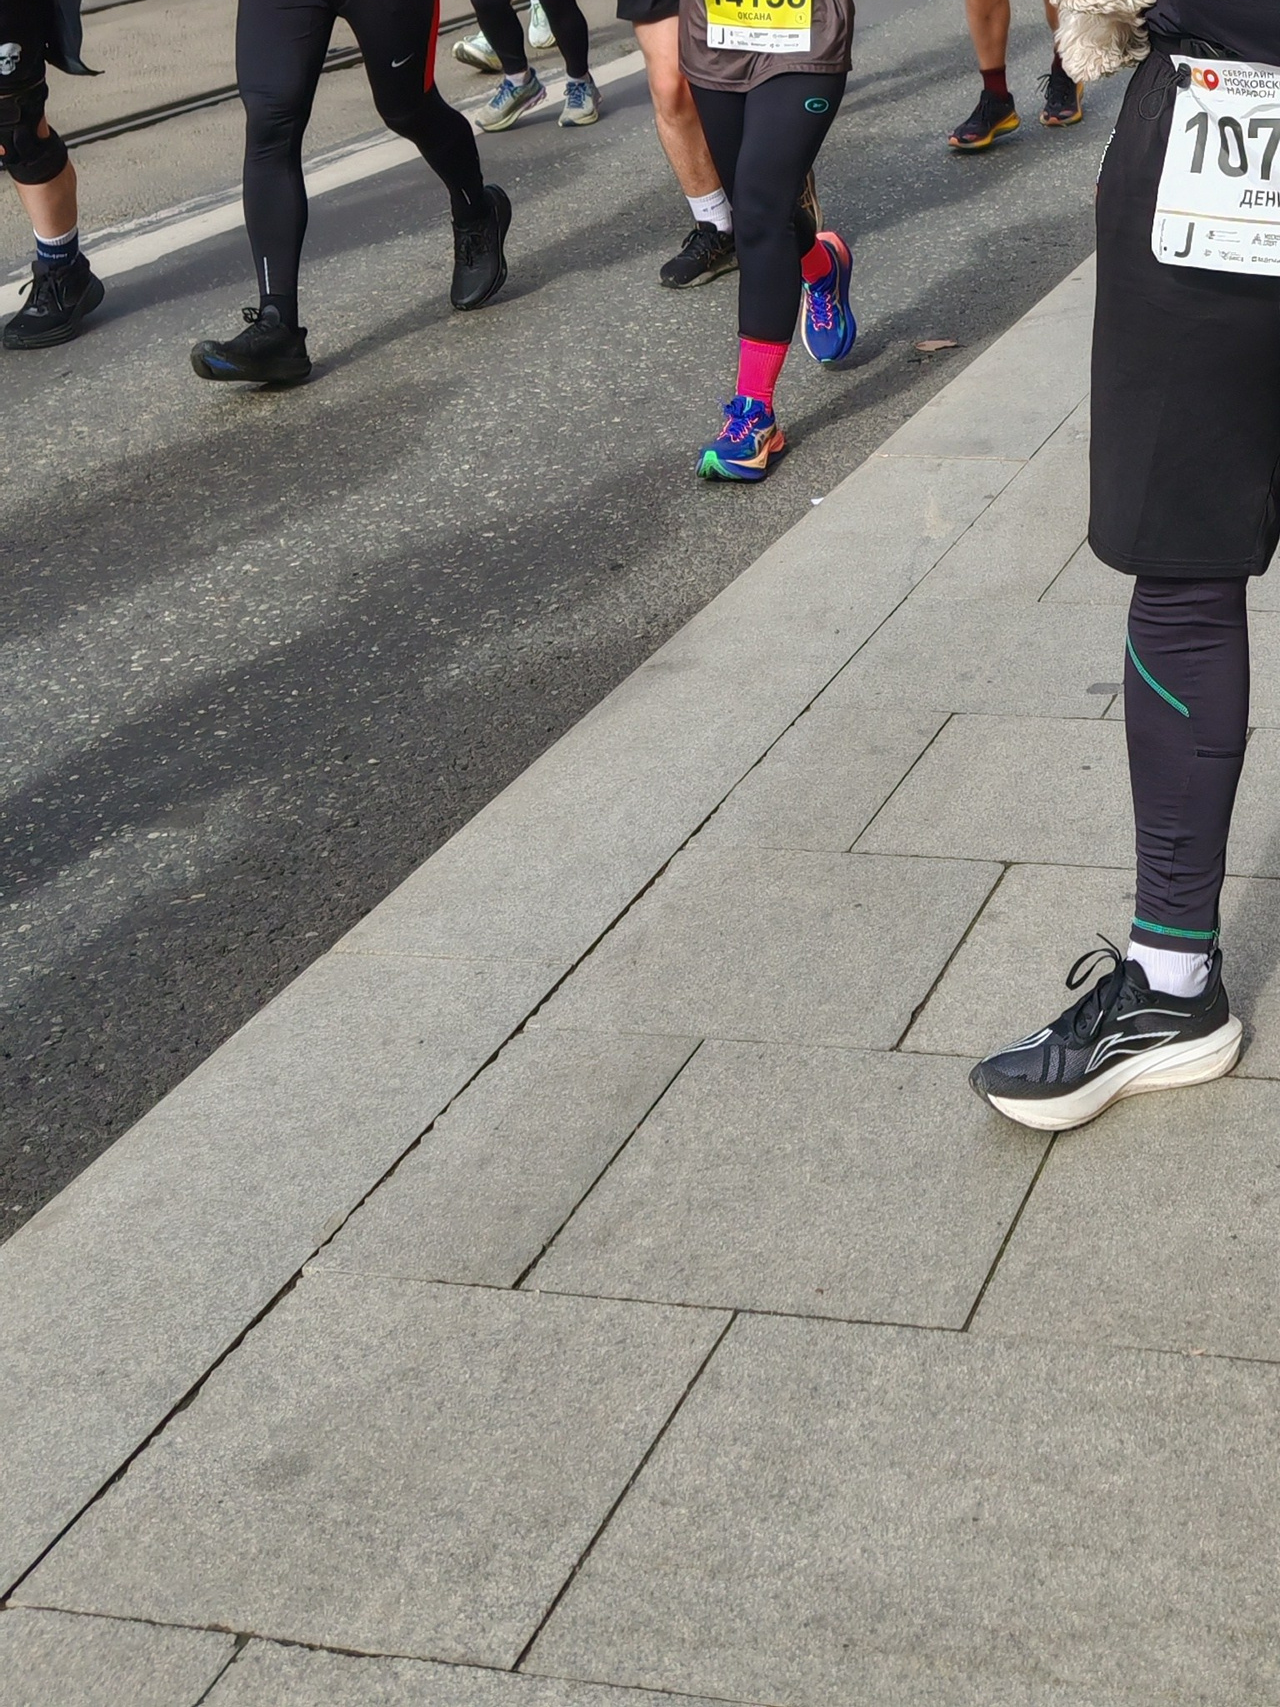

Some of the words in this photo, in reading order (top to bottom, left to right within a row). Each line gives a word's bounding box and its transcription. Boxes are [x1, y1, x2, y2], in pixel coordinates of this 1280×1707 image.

[737, 11, 772, 21] ОКСАНА
[1222, 69, 1275, 79] СБЕРПРАЙМ
[1226, 87, 1276, 99] МАРАФОН
[1174, 222, 1196, 259] J
